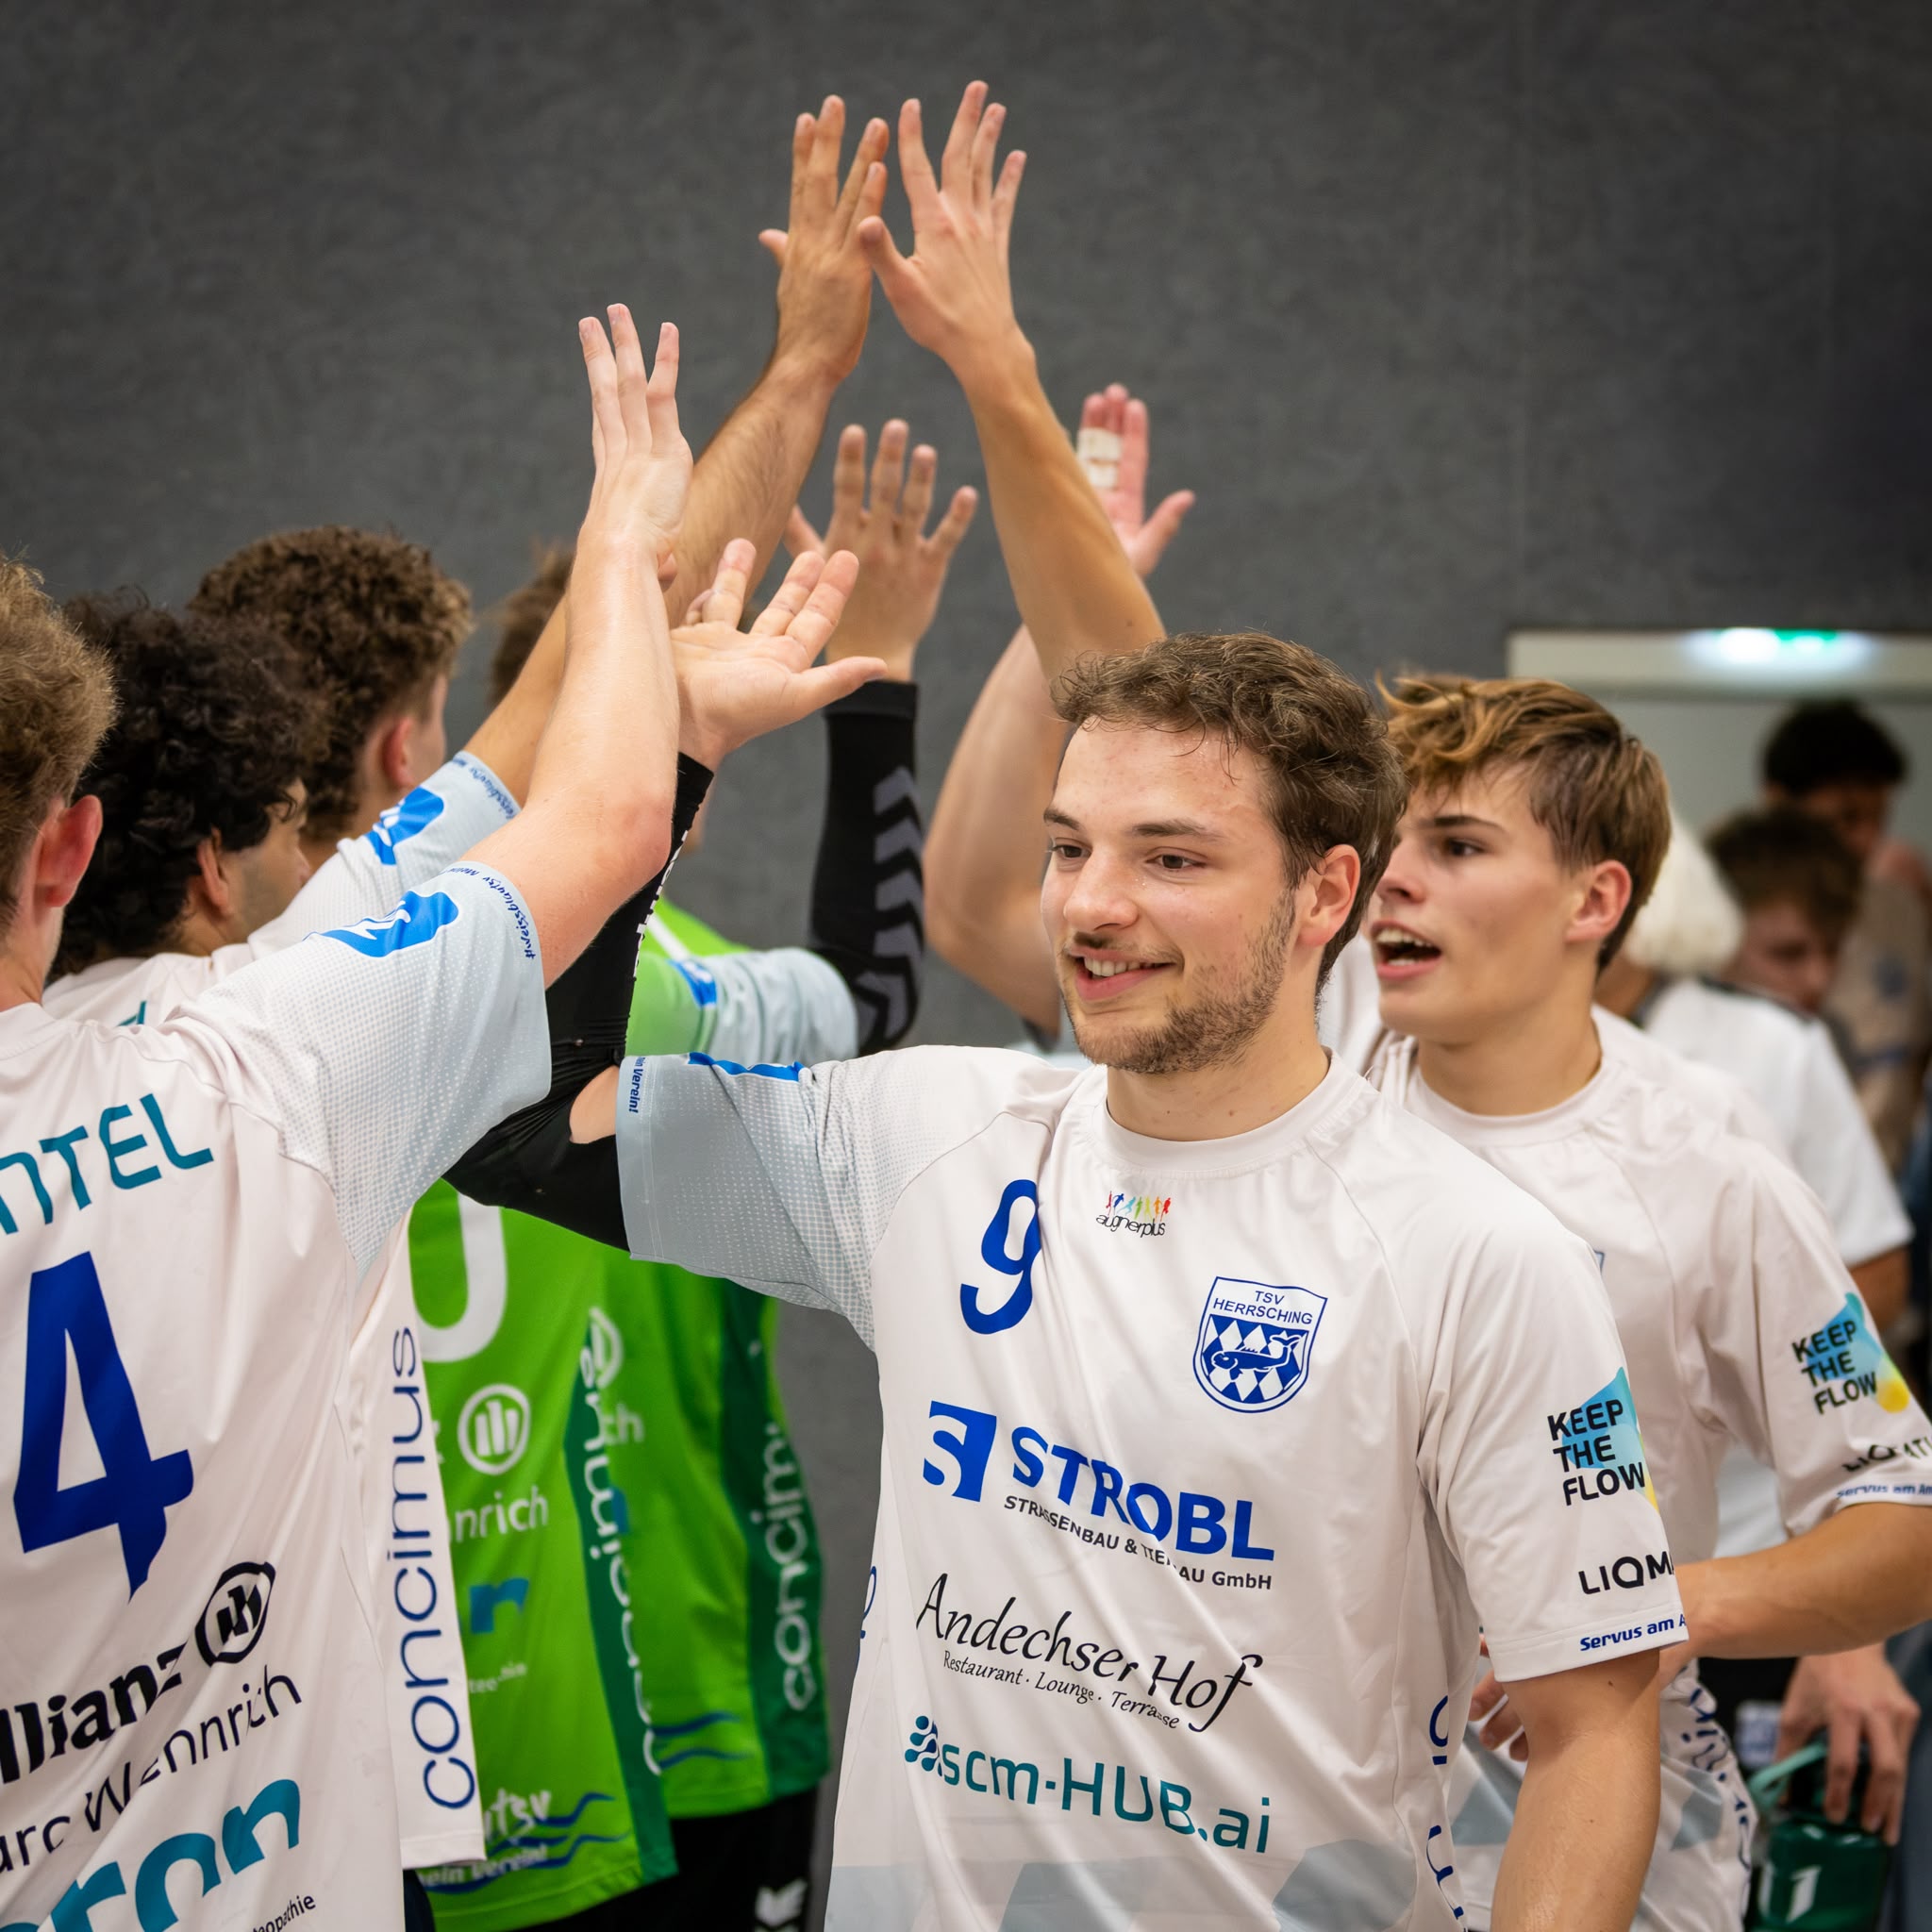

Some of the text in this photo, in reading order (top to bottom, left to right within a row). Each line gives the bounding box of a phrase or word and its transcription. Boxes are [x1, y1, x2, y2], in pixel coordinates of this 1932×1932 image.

[1095, 1213, 1167, 1239] augnerplus
[959, 1178, 1041, 1335] 9
[1212, 1297, 1314, 1325] HERRSCHING
[1254, 1290, 1286, 1306] TSV
[1790, 1319, 1858, 1363] KEEP
[1801, 1350, 1857, 1389] THE
[1813, 1371, 1878, 1415] FLOW
[13, 1250, 195, 1605] 4
[1546, 1398, 1624, 1442] KEEP
[1553, 1434, 1616, 1474] THE
[1010, 1424, 1275, 1562] STROBL
[1562, 1461, 1646, 1507] FLOW
[448, 1484, 549, 1544] nrich
[1003, 1494, 1120, 1551] STRASSENBAU
[1123, 1538, 1139, 1556] &
[1210, 1570, 1273, 1591] GmbH
[387, 1325, 476, 1809] concimus
[1577, 1550, 1675, 1595] LIQM
[915, 1572, 1140, 1684] Andechser
[1147, 1653, 1264, 1734] Hof
[1579, 1625, 1643, 1652] Servus
[1646, 1618, 1675, 1635] am
[942, 1649, 1024, 1686] Restaurant
[1034, 1671, 1095, 1705] Lounge
